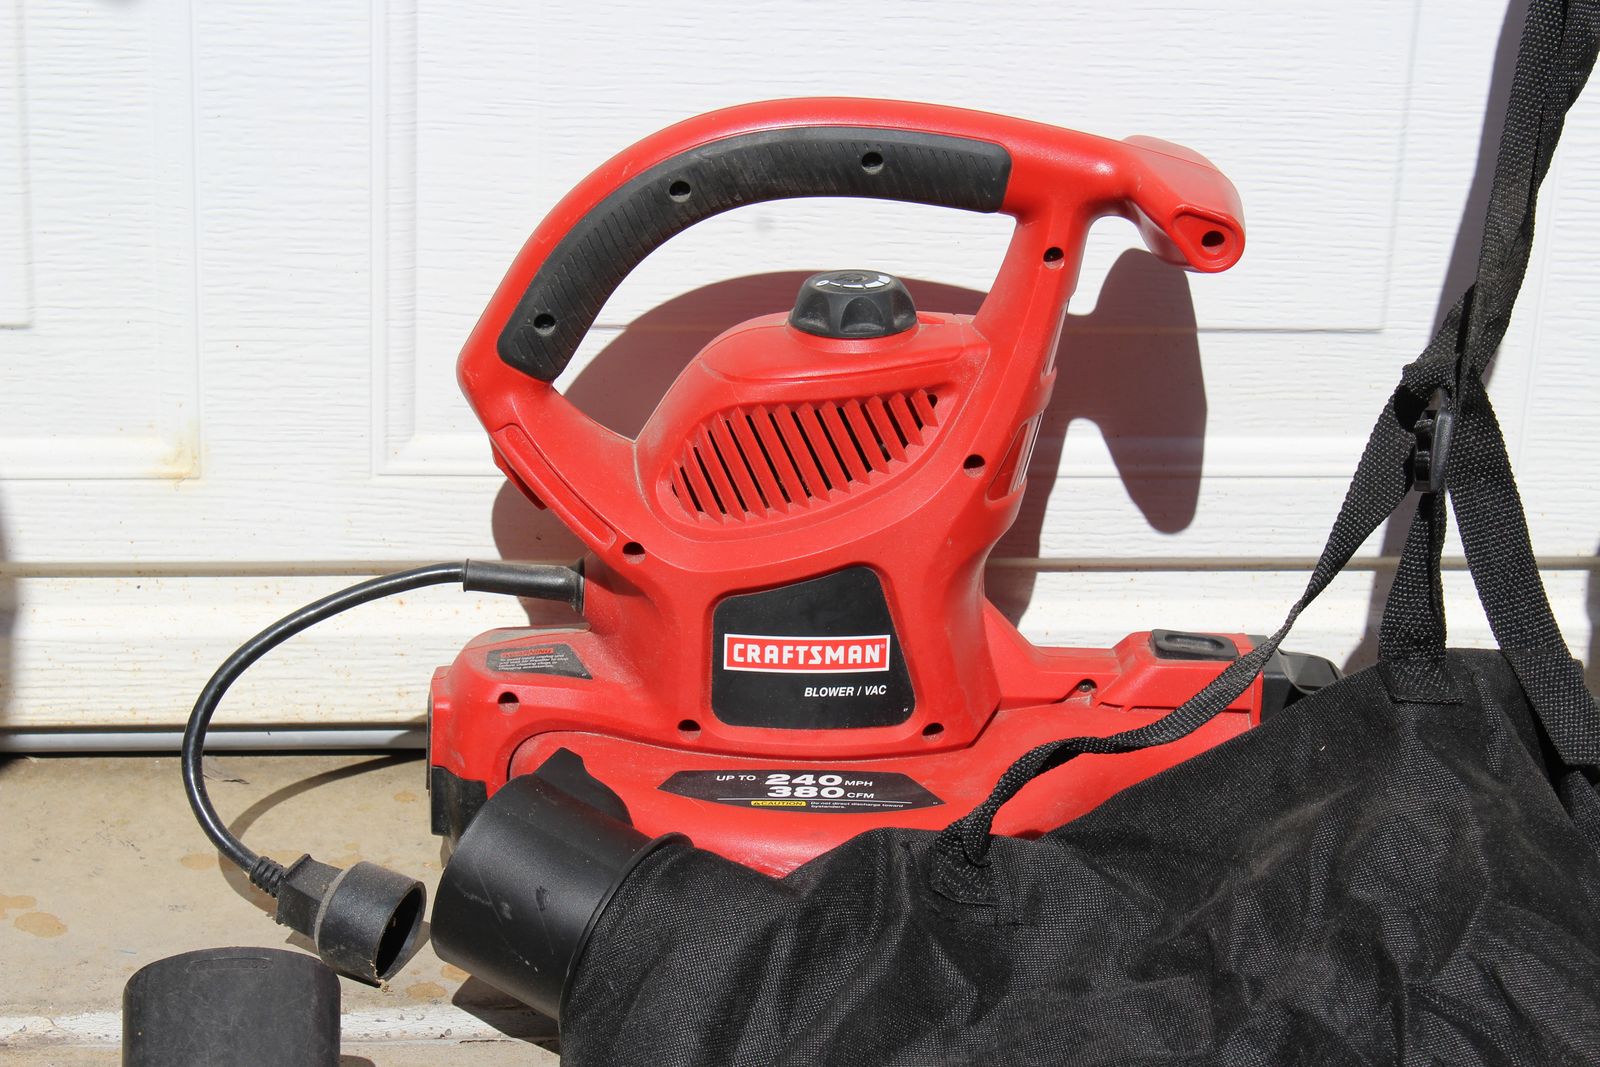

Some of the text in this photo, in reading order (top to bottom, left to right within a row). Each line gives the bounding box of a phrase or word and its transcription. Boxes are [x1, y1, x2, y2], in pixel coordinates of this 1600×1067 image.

[733, 643, 880, 665] CRAFTSMAN
[804, 685, 887, 698] BLOWER / VAC
[765, 773, 843, 786] 240
[767, 786, 845, 798] 380
